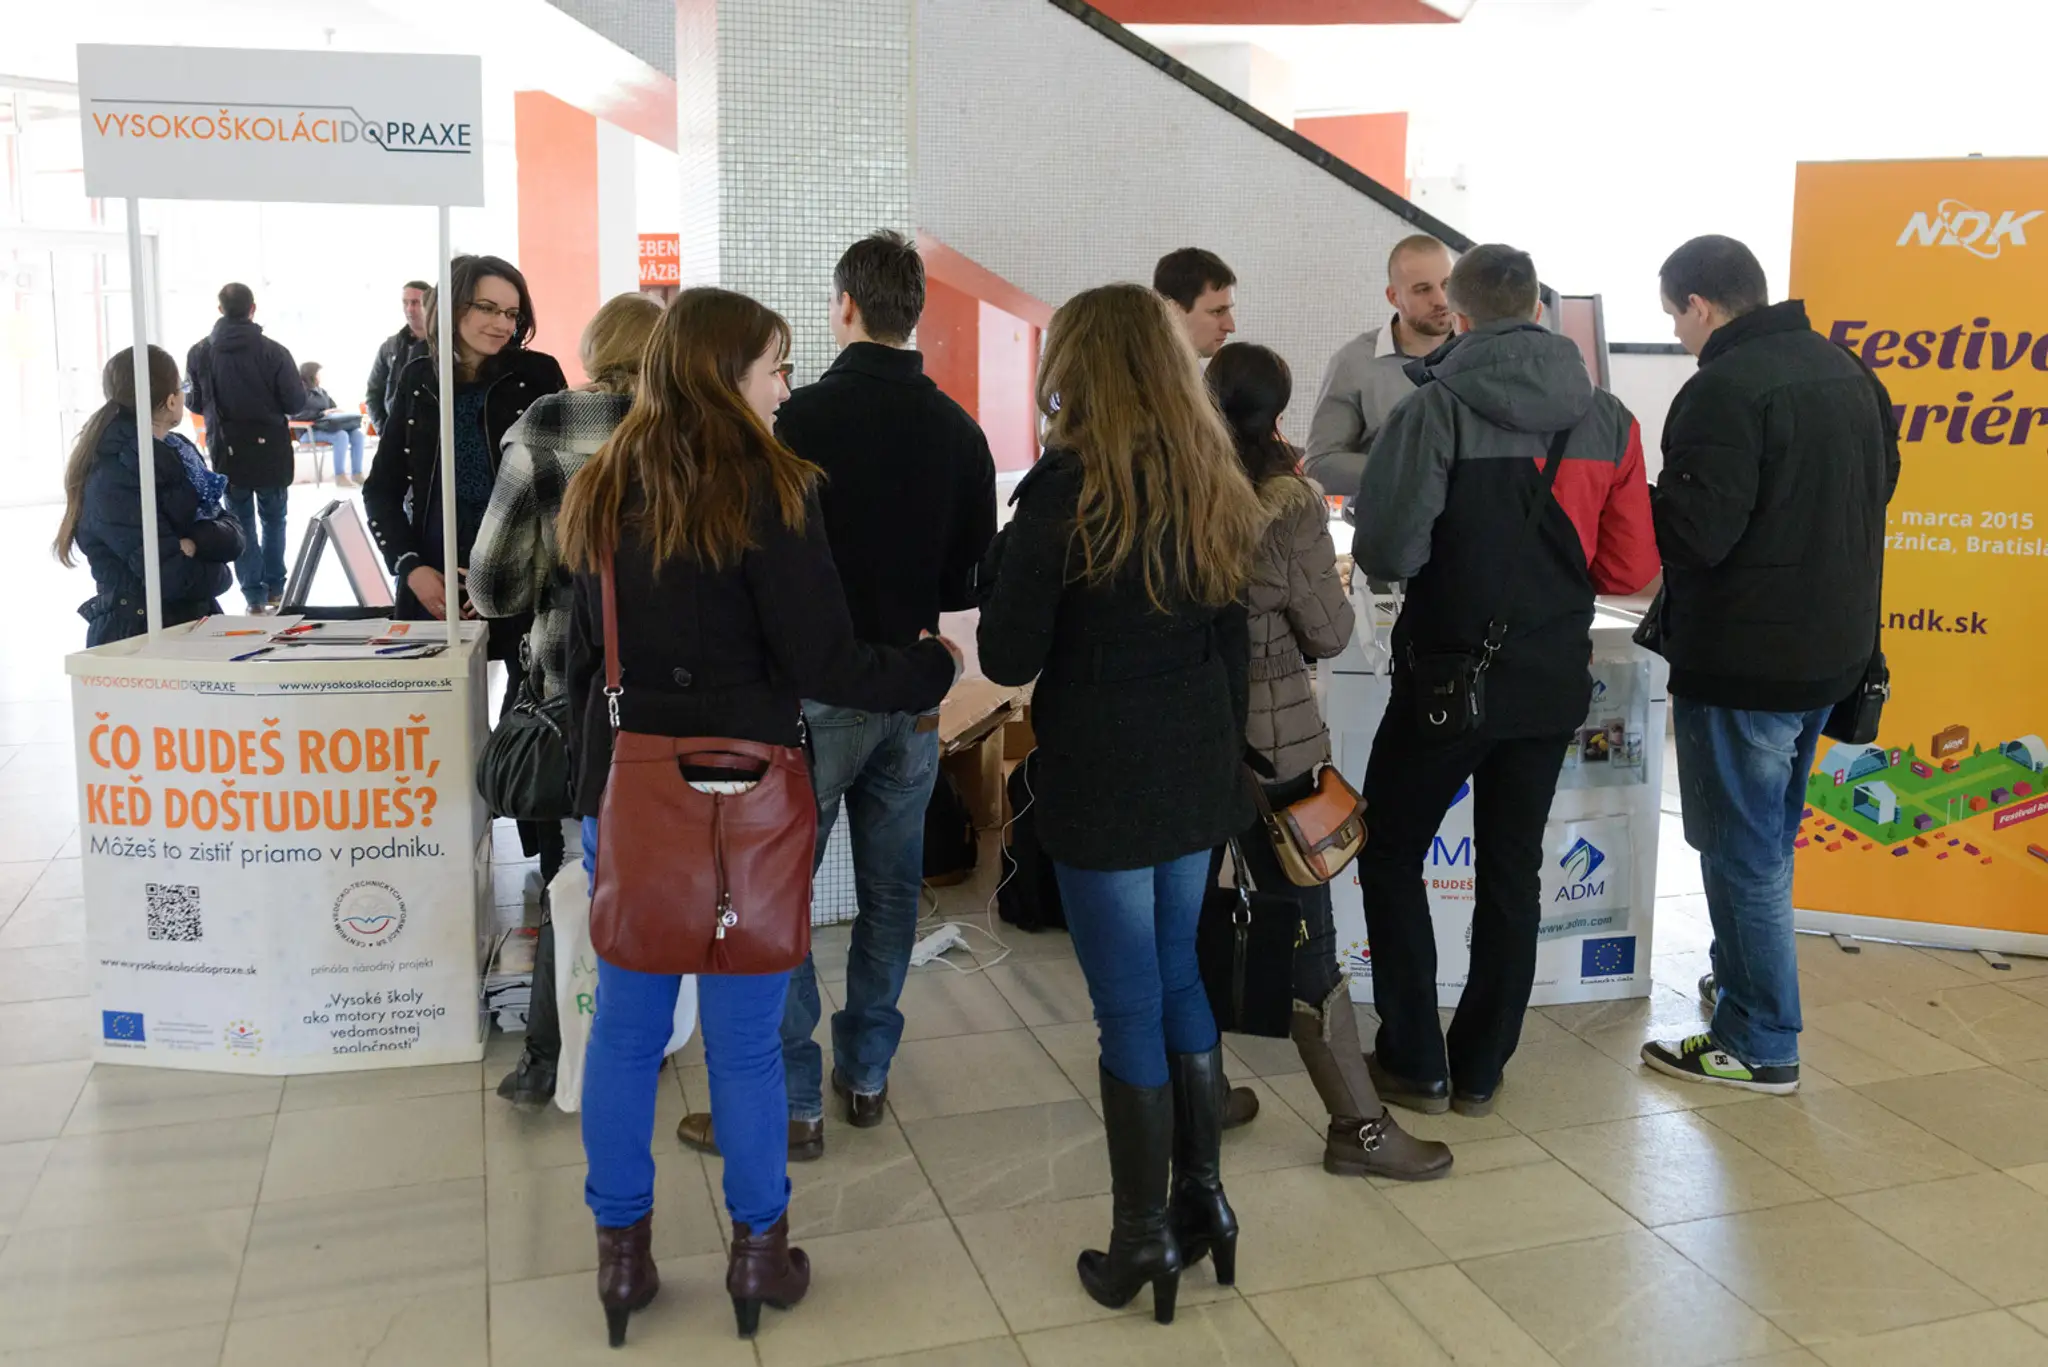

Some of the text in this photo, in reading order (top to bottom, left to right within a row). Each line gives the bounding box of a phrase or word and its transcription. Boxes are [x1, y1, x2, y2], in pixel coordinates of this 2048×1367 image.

[91, 107, 472, 148] VYSOKOŠKOLÁCIDOPRAXE
[1896, 205, 2046, 250] NDK
[637, 239, 679, 257] EBEN
[638, 260, 680, 281] VÄZB
[1901, 510, 1973, 528] marca
[1980, 510, 2034, 531] 2015
[1884, 531, 1957, 555] ržnica,
[1880, 607, 1989, 635] .ndk.sk
[87, 711, 442, 779] ČO BUDEŠ ROBIŤ,
[86, 774, 439, 833] KEĎ DOŠTUDUJEŠ?
[90, 835, 446, 869] Môžeš to zistiť priamo v podniku.
[1554, 880, 1605, 902] ADM
[387, 987, 424, 1005] školy
[302, 1004, 446, 1025] ako motory rozvoja
[329, 1021, 421, 1039] vedomostnej
